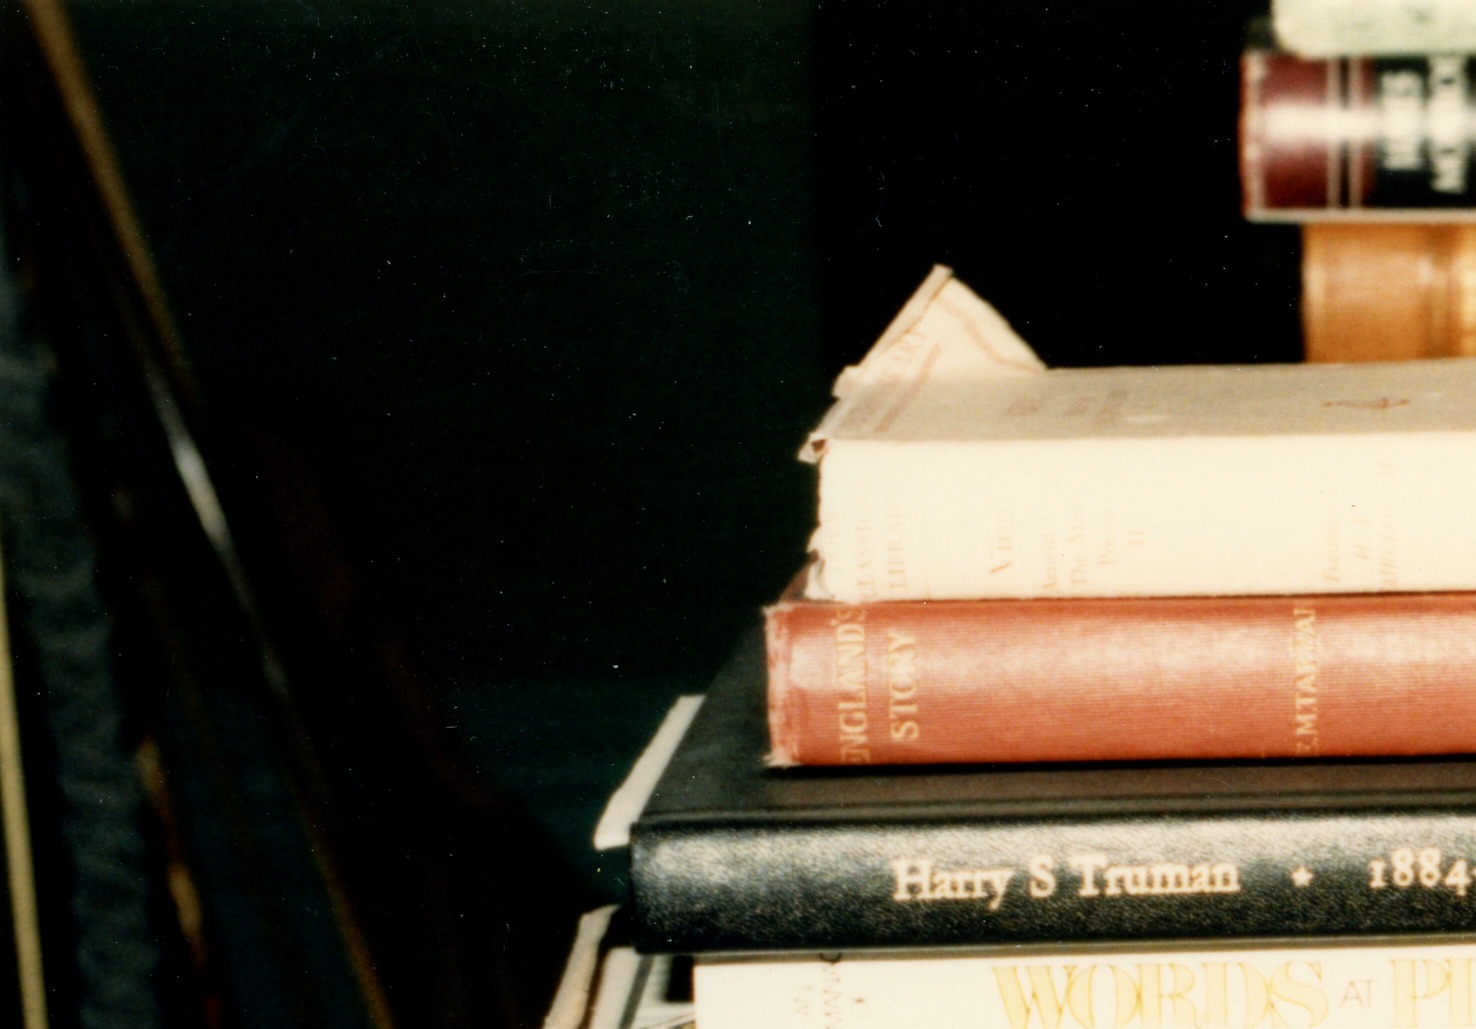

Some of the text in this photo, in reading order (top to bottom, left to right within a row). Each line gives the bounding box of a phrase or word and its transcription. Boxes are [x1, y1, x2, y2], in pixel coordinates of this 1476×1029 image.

[886, 630, 919, 742] STORY
[893, 857, 1013, 911] Harry
[1028, 854, 1056, 898] S
[1069, 851, 1241, 896] Truman
